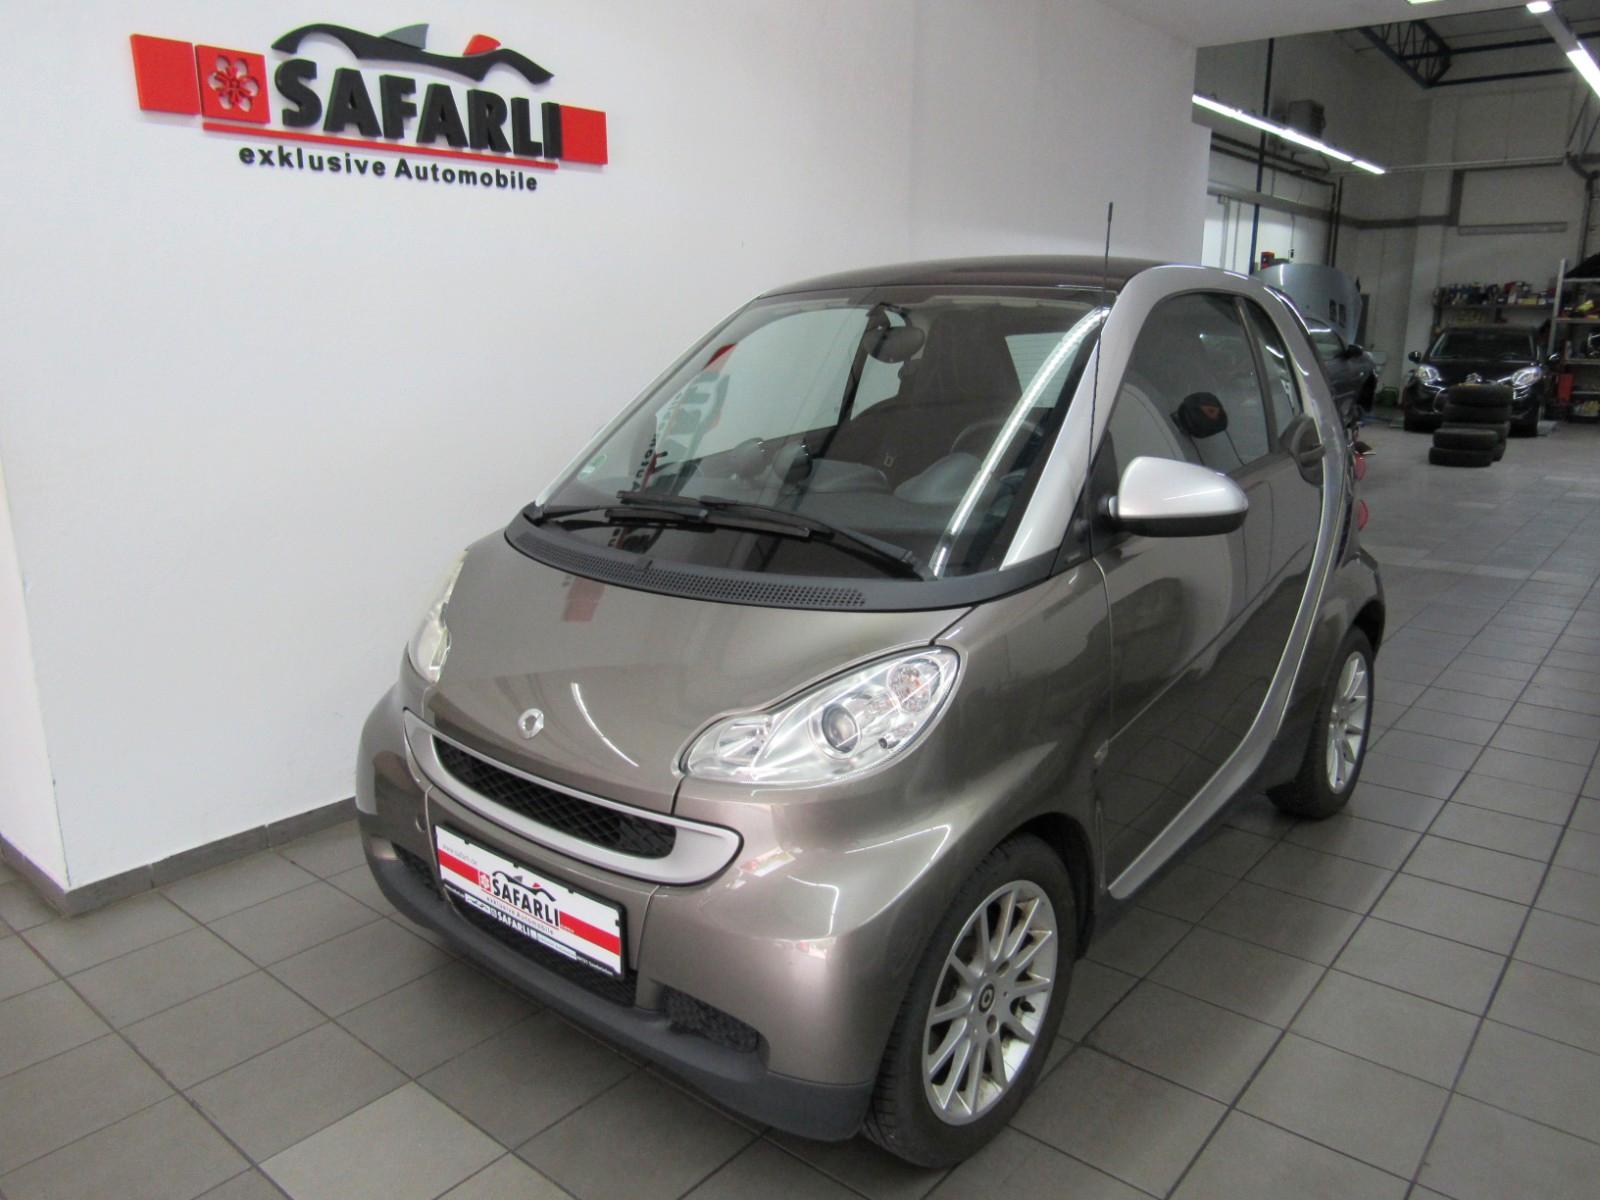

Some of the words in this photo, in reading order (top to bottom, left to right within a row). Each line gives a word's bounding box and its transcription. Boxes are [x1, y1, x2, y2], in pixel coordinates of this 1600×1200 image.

[274, 59, 562, 159] SAFARLI
[239, 144, 386, 177] exklusive
[394, 159, 537, 191] Automobile
[492, 878, 560, 927] SAFARLI
